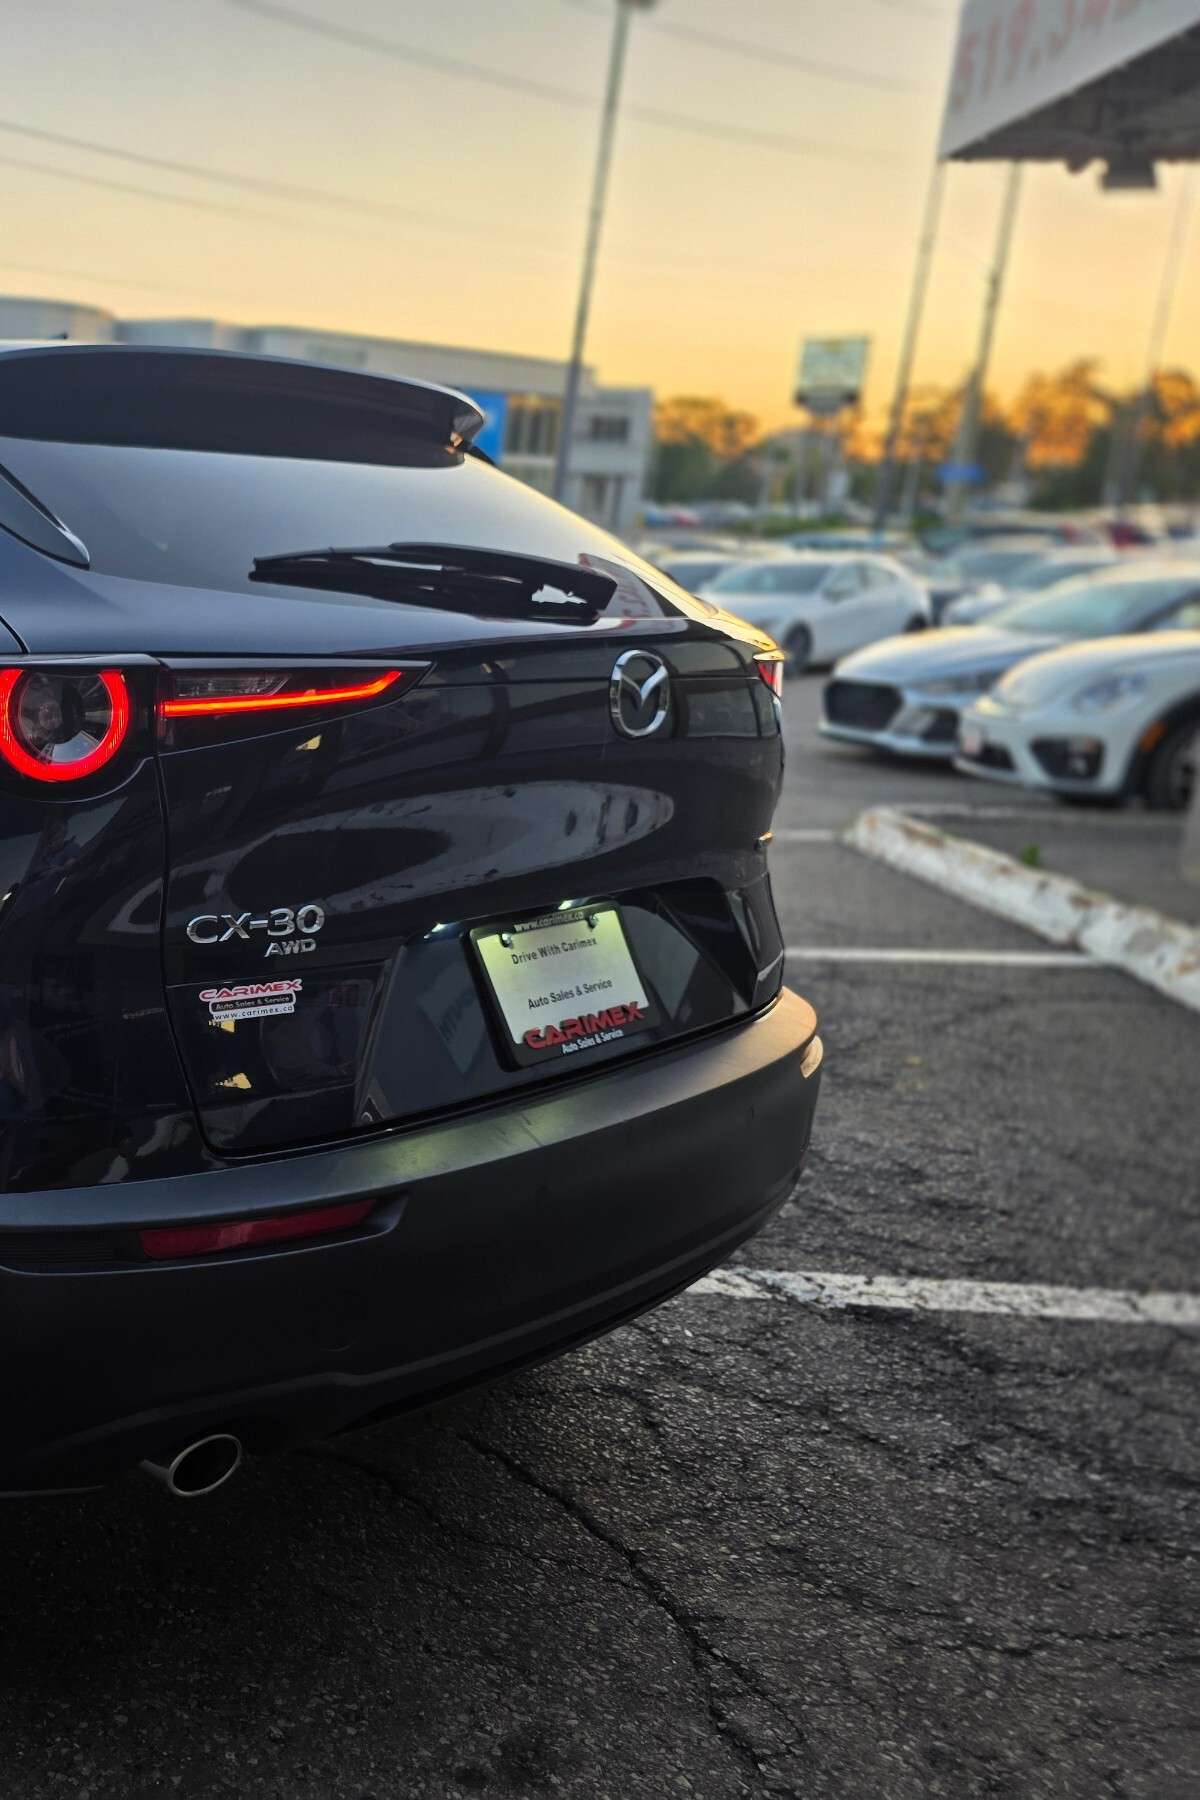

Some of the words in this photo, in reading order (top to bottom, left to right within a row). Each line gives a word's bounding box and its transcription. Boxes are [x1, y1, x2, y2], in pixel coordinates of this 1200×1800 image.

[186, 904, 325, 944] CX-30
[264, 938, 317, 957] AWD
[511, 952, 538, 965] Drive
[537, 944, 561, 958] With
[561, 937, 598, 952] Carimex
[200, 979, 302, 1001] CARIMEX
[215, 1001, 234, 1010] Auto
[234, 1000, 256, 1008] Sales
[264, 995, 291, 1004] Service
[528, 998, 549, 1010] Auto
[550, 989, 574, 1004] Sales
[583, 979, 613, 993] Service
[523, 1001, 645, 1049] CARIMEX
[561, 1041, 577, 1054] Auto
[577, 1034, 595, 1049] Sales
[602, 1027, 625, 1042] Service
